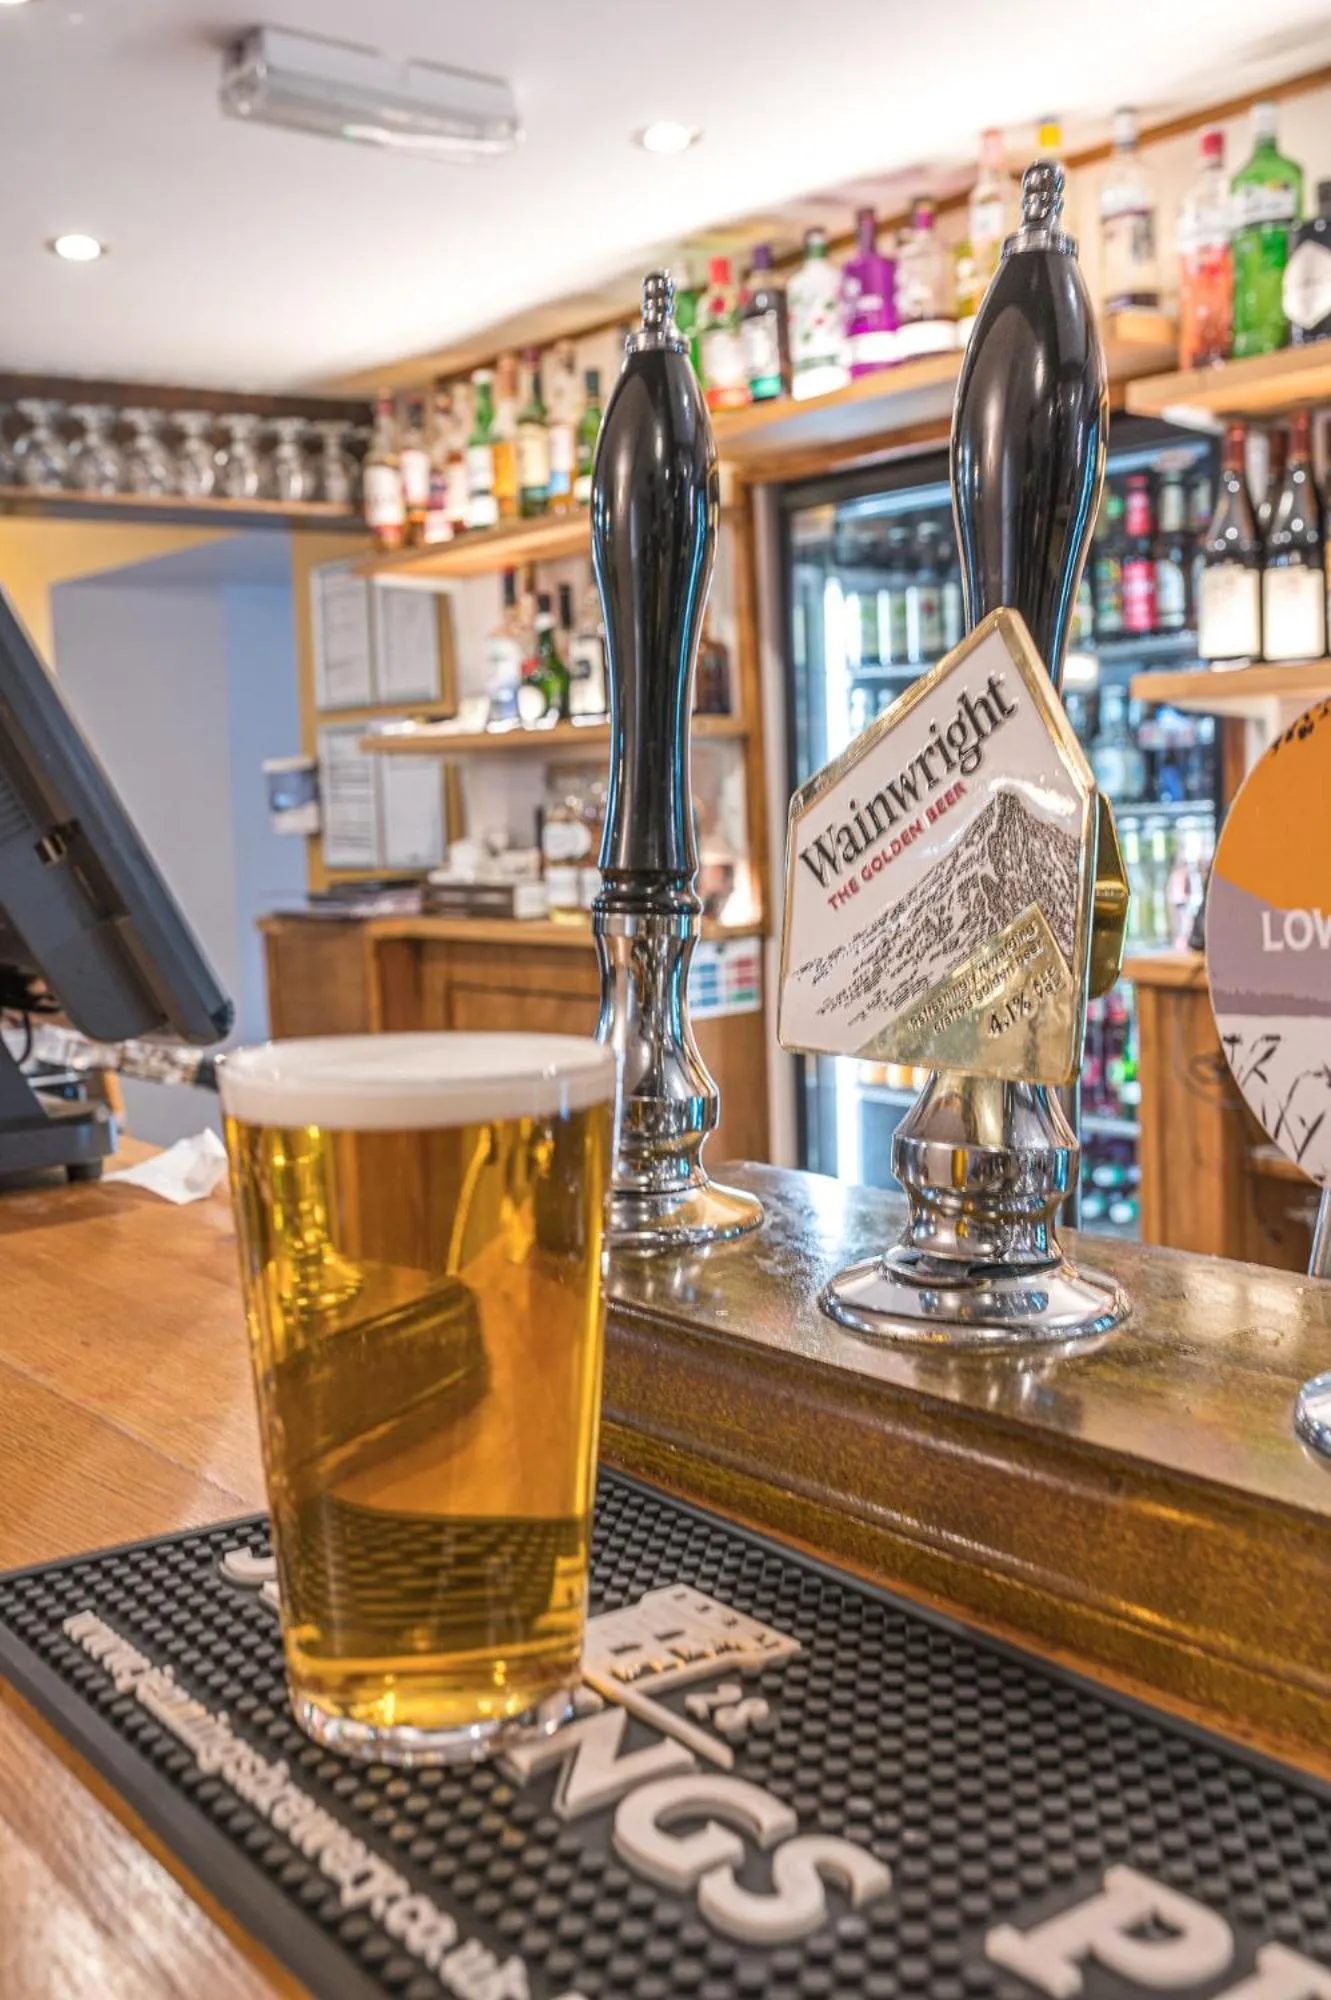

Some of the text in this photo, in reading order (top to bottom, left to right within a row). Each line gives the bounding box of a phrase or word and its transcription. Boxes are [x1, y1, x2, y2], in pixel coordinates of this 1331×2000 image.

[798, 675, 1018, 889] Wainwright
[827, 779, 968, 912] THE GOLDEN BEER
[988, 990, 1033, 1036] 4.1%
